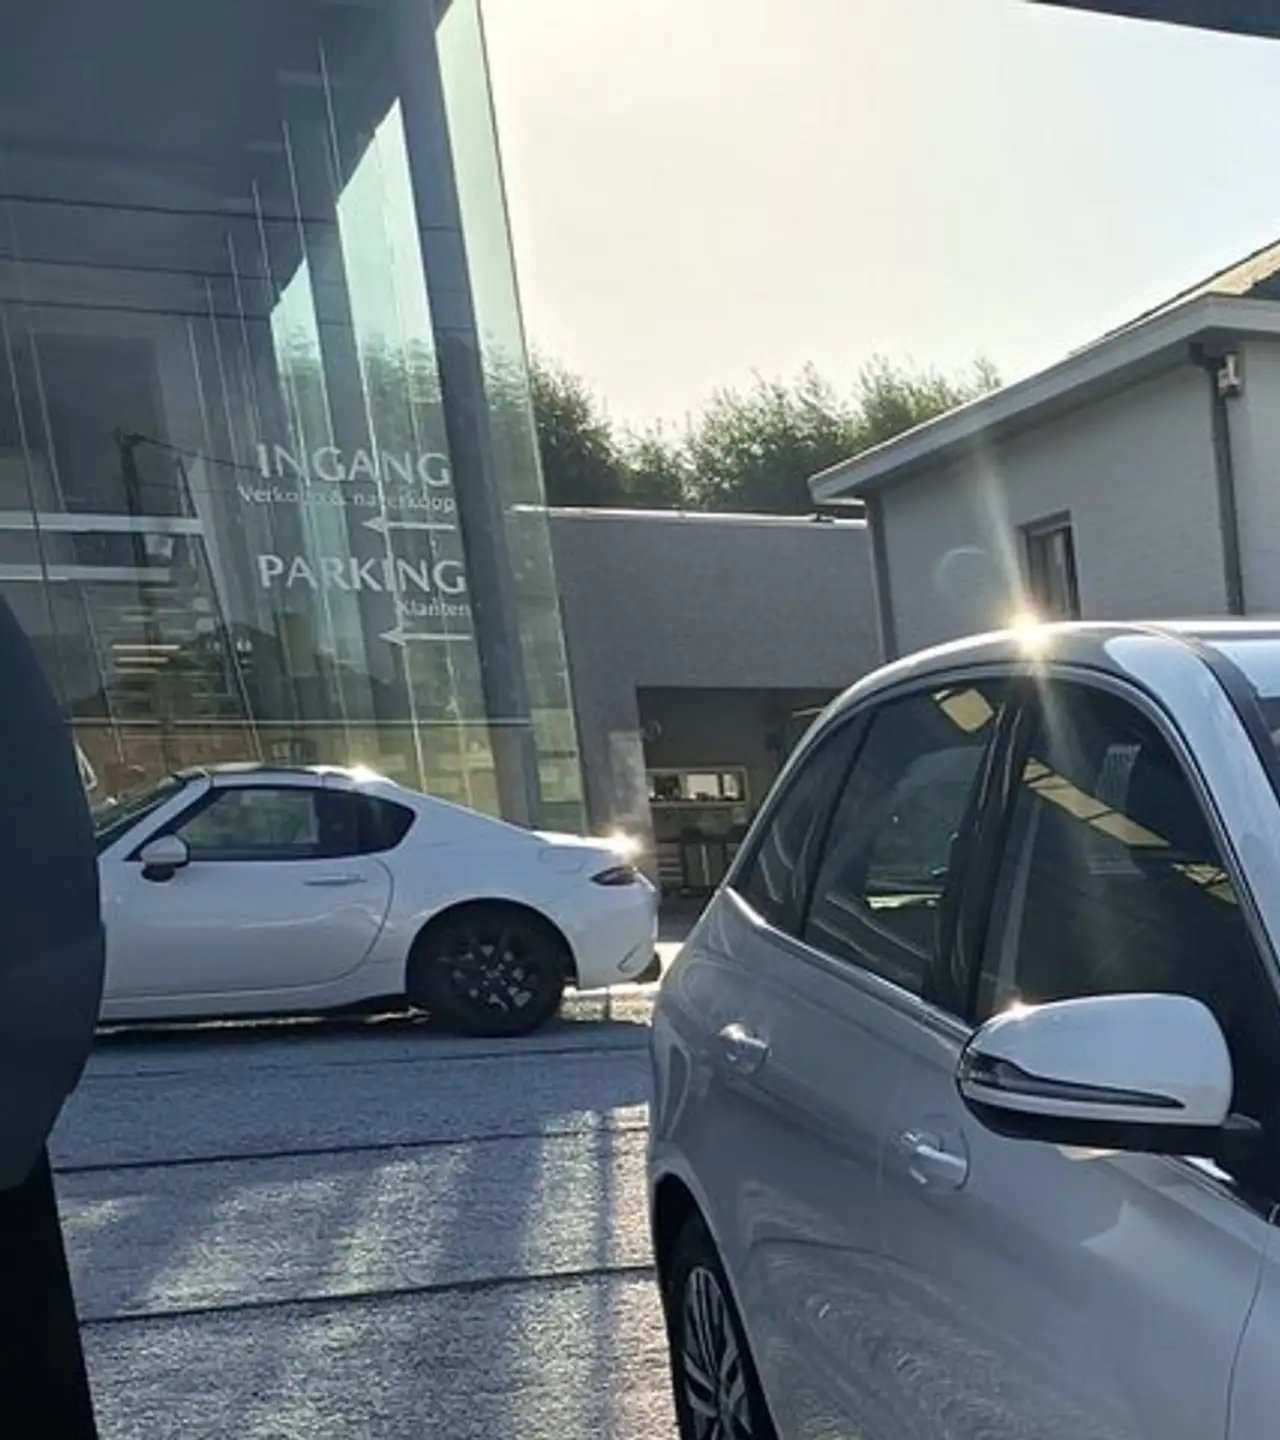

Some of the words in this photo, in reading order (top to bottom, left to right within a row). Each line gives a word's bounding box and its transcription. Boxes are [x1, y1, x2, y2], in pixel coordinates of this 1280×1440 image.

[256, 443, 451, 488] INGANG
[236, 483, 325, 506] Verko
[257, 554, 467, 595] PARKING
[396, 599, 471, 617] Klanten
